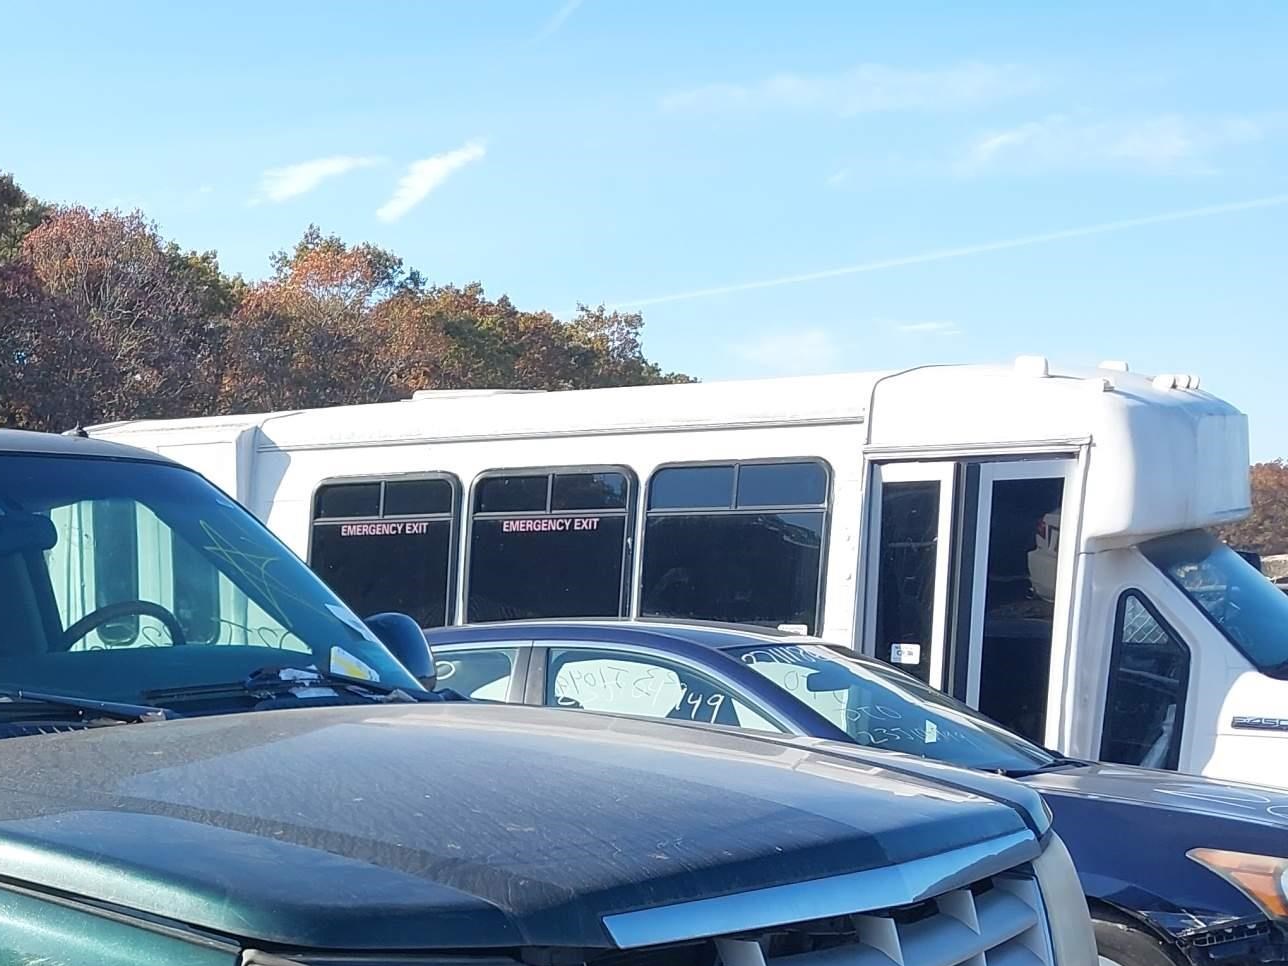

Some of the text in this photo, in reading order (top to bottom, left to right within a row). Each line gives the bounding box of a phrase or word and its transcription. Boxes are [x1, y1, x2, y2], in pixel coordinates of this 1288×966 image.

[340, 522, 429, 536] EMERGENCY EXIT
[502, 518, 600, 532] EMERGENCY EXIT
